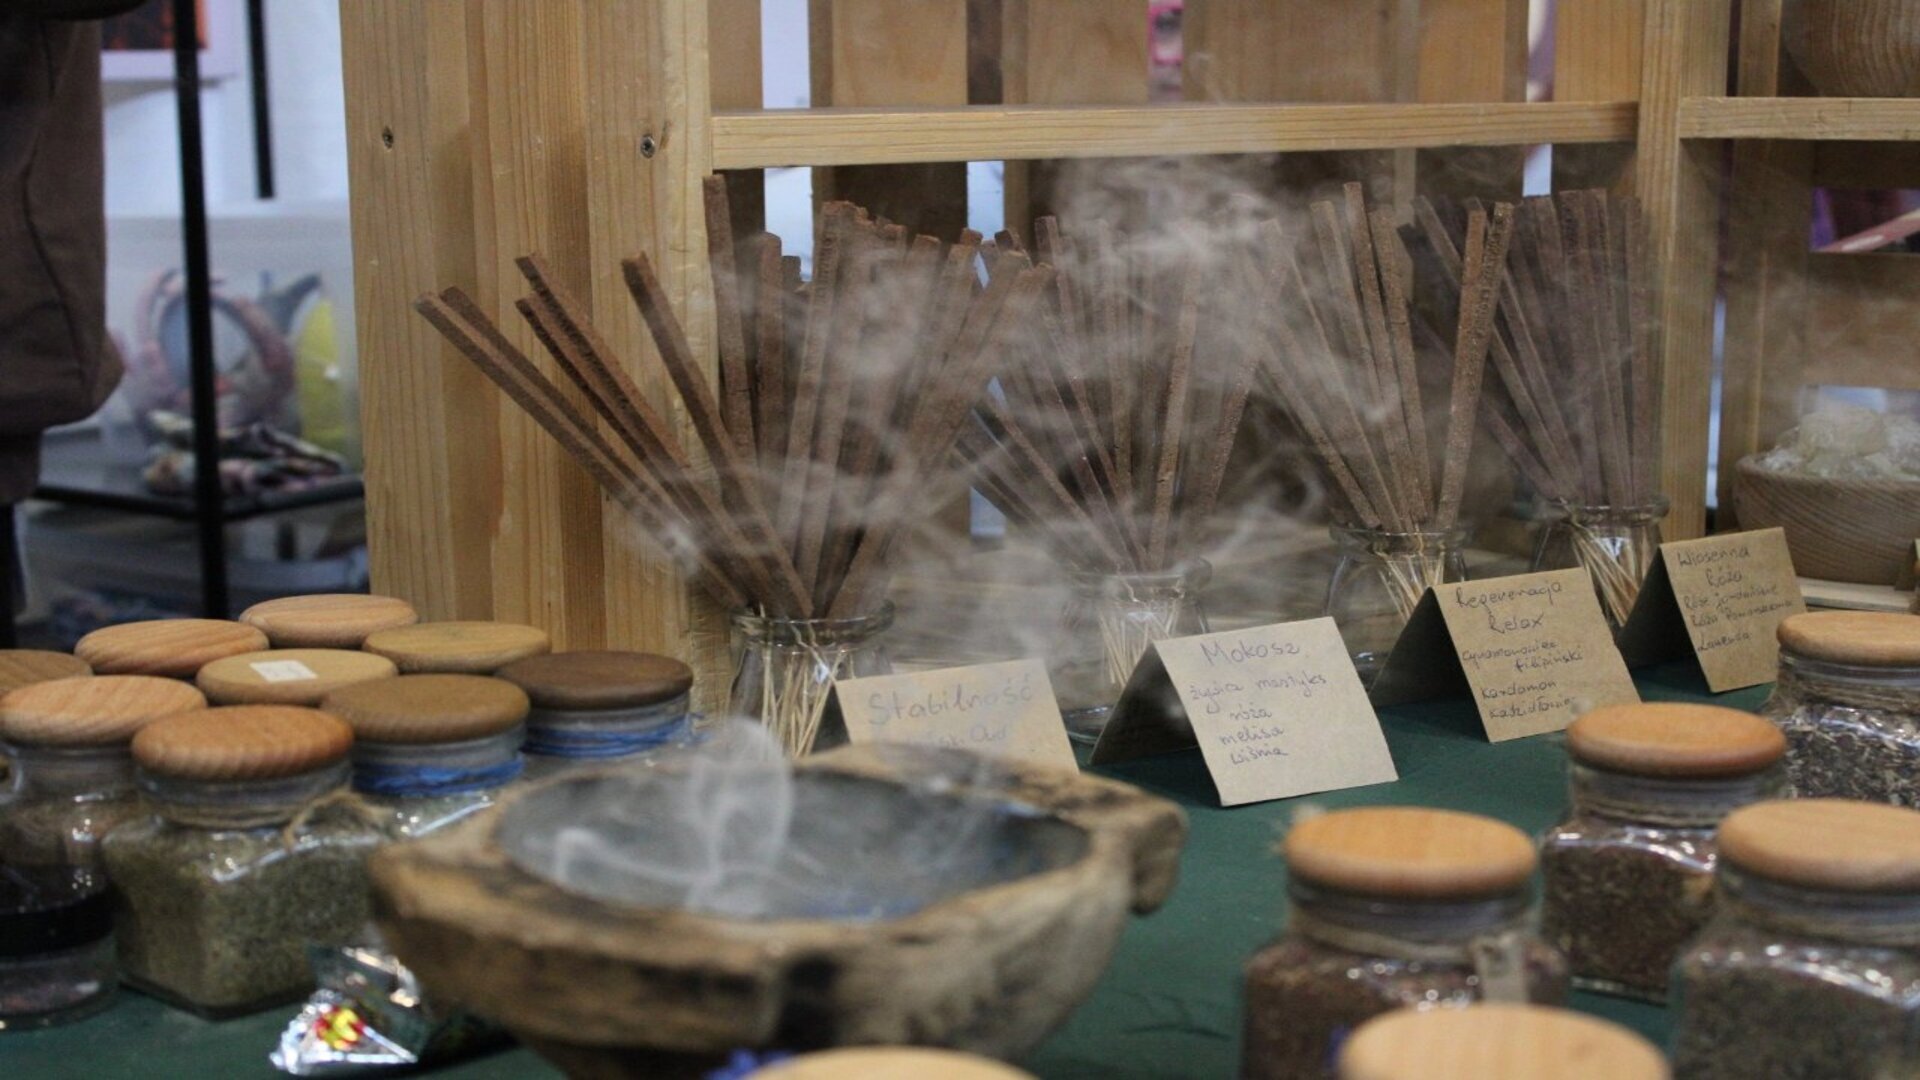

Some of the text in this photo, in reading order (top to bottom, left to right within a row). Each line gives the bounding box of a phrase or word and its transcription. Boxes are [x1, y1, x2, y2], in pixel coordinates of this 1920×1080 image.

[1456, 579, 1563, 612] Regeneracja
[1488, 611, 1545, 633] Relax
[1200, 640, 1300, 666] Mokosz
[867, 673, 1034, 725] Stabilność
[1218, 726, 1285, 746] melisa
